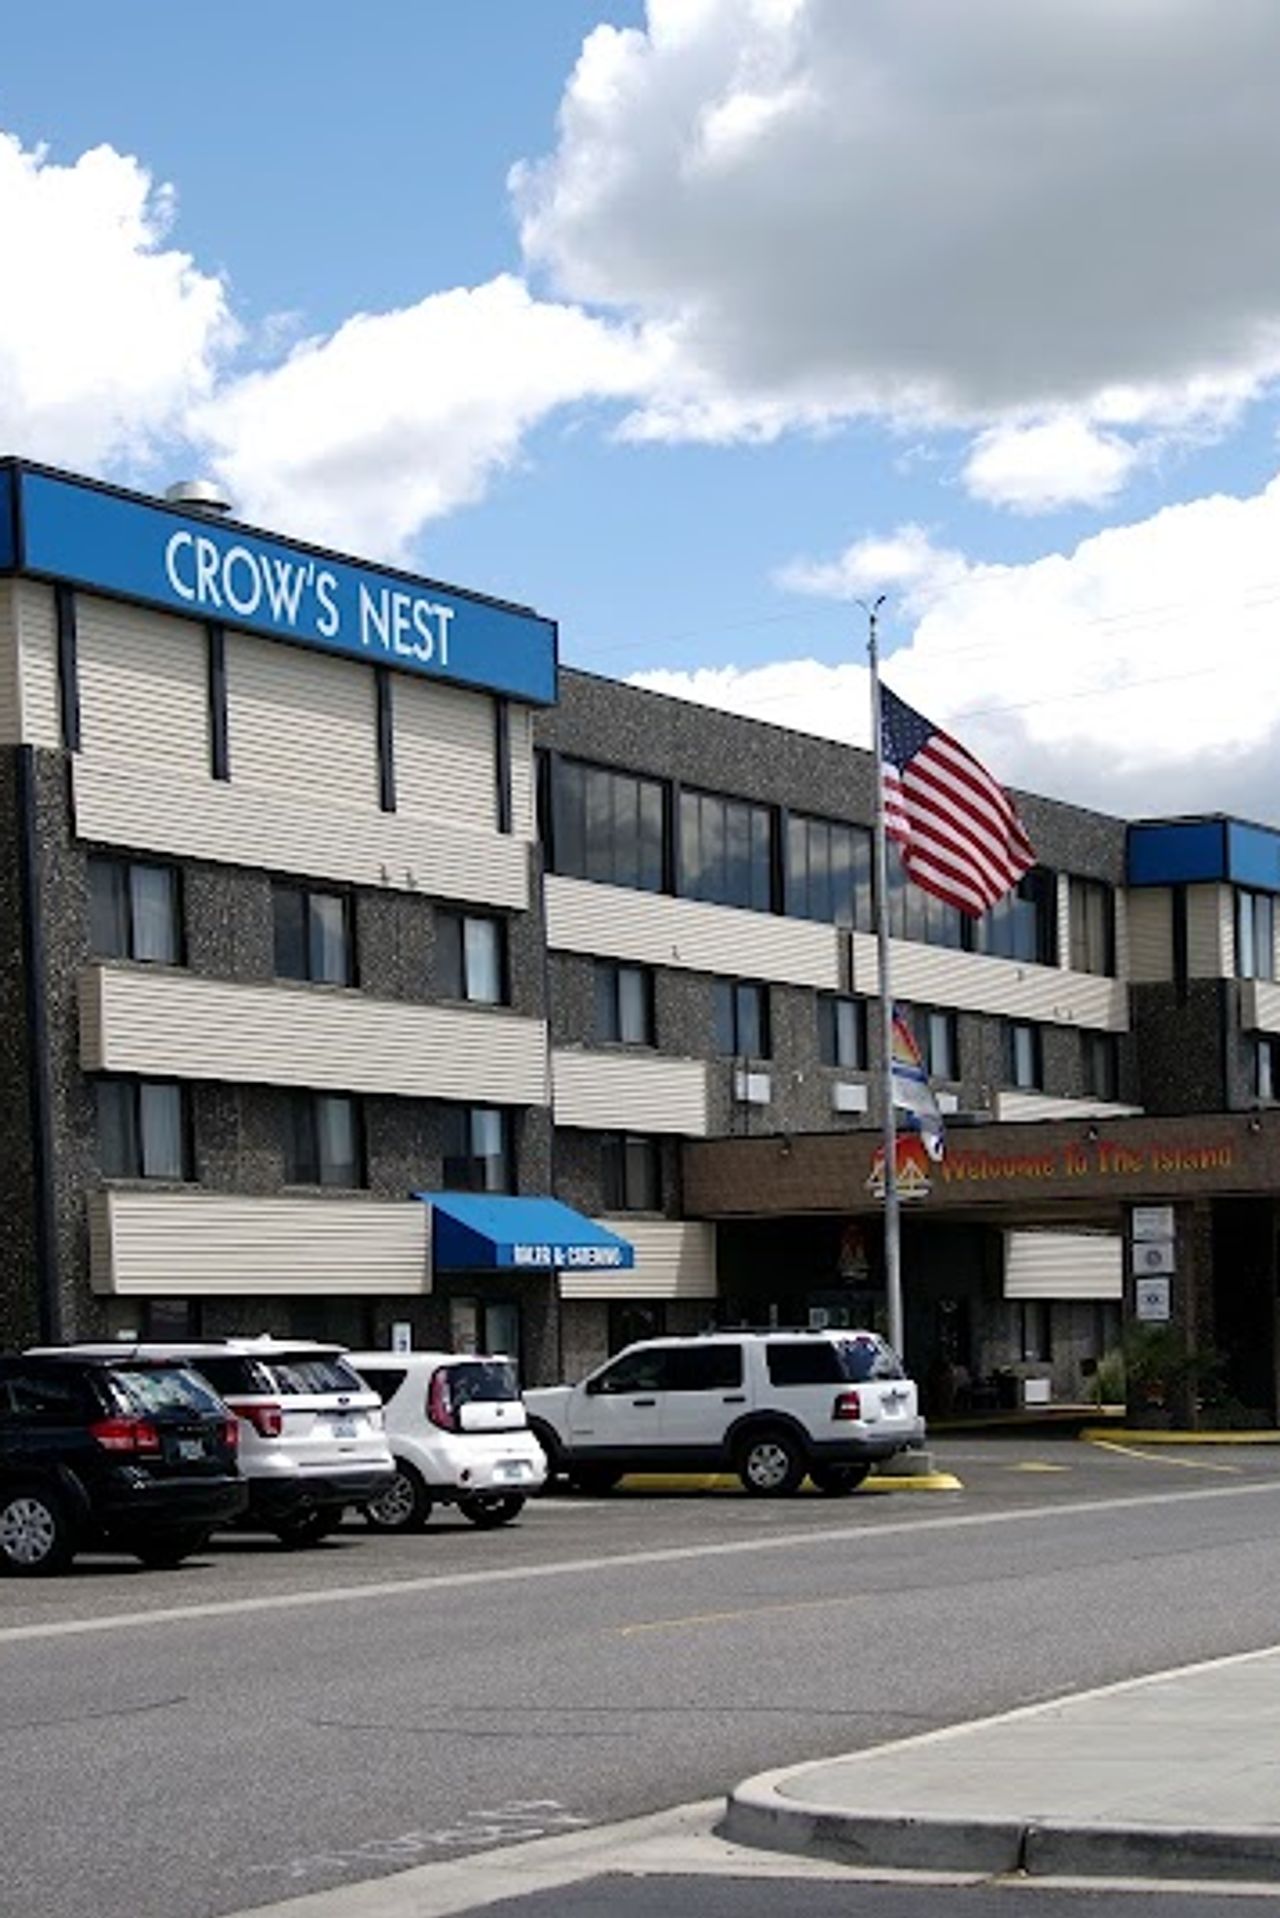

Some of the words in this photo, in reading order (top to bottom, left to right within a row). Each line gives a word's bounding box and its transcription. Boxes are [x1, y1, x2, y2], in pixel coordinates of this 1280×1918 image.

[165, 531, 339, 637] CROW'S
[359, 584, 454, 665] NEST
[943, 1150, 1054, 1182] Welcome
[1065, 1142, 1087, 1175] To
[1098, 1141, 1144, 1173] The
